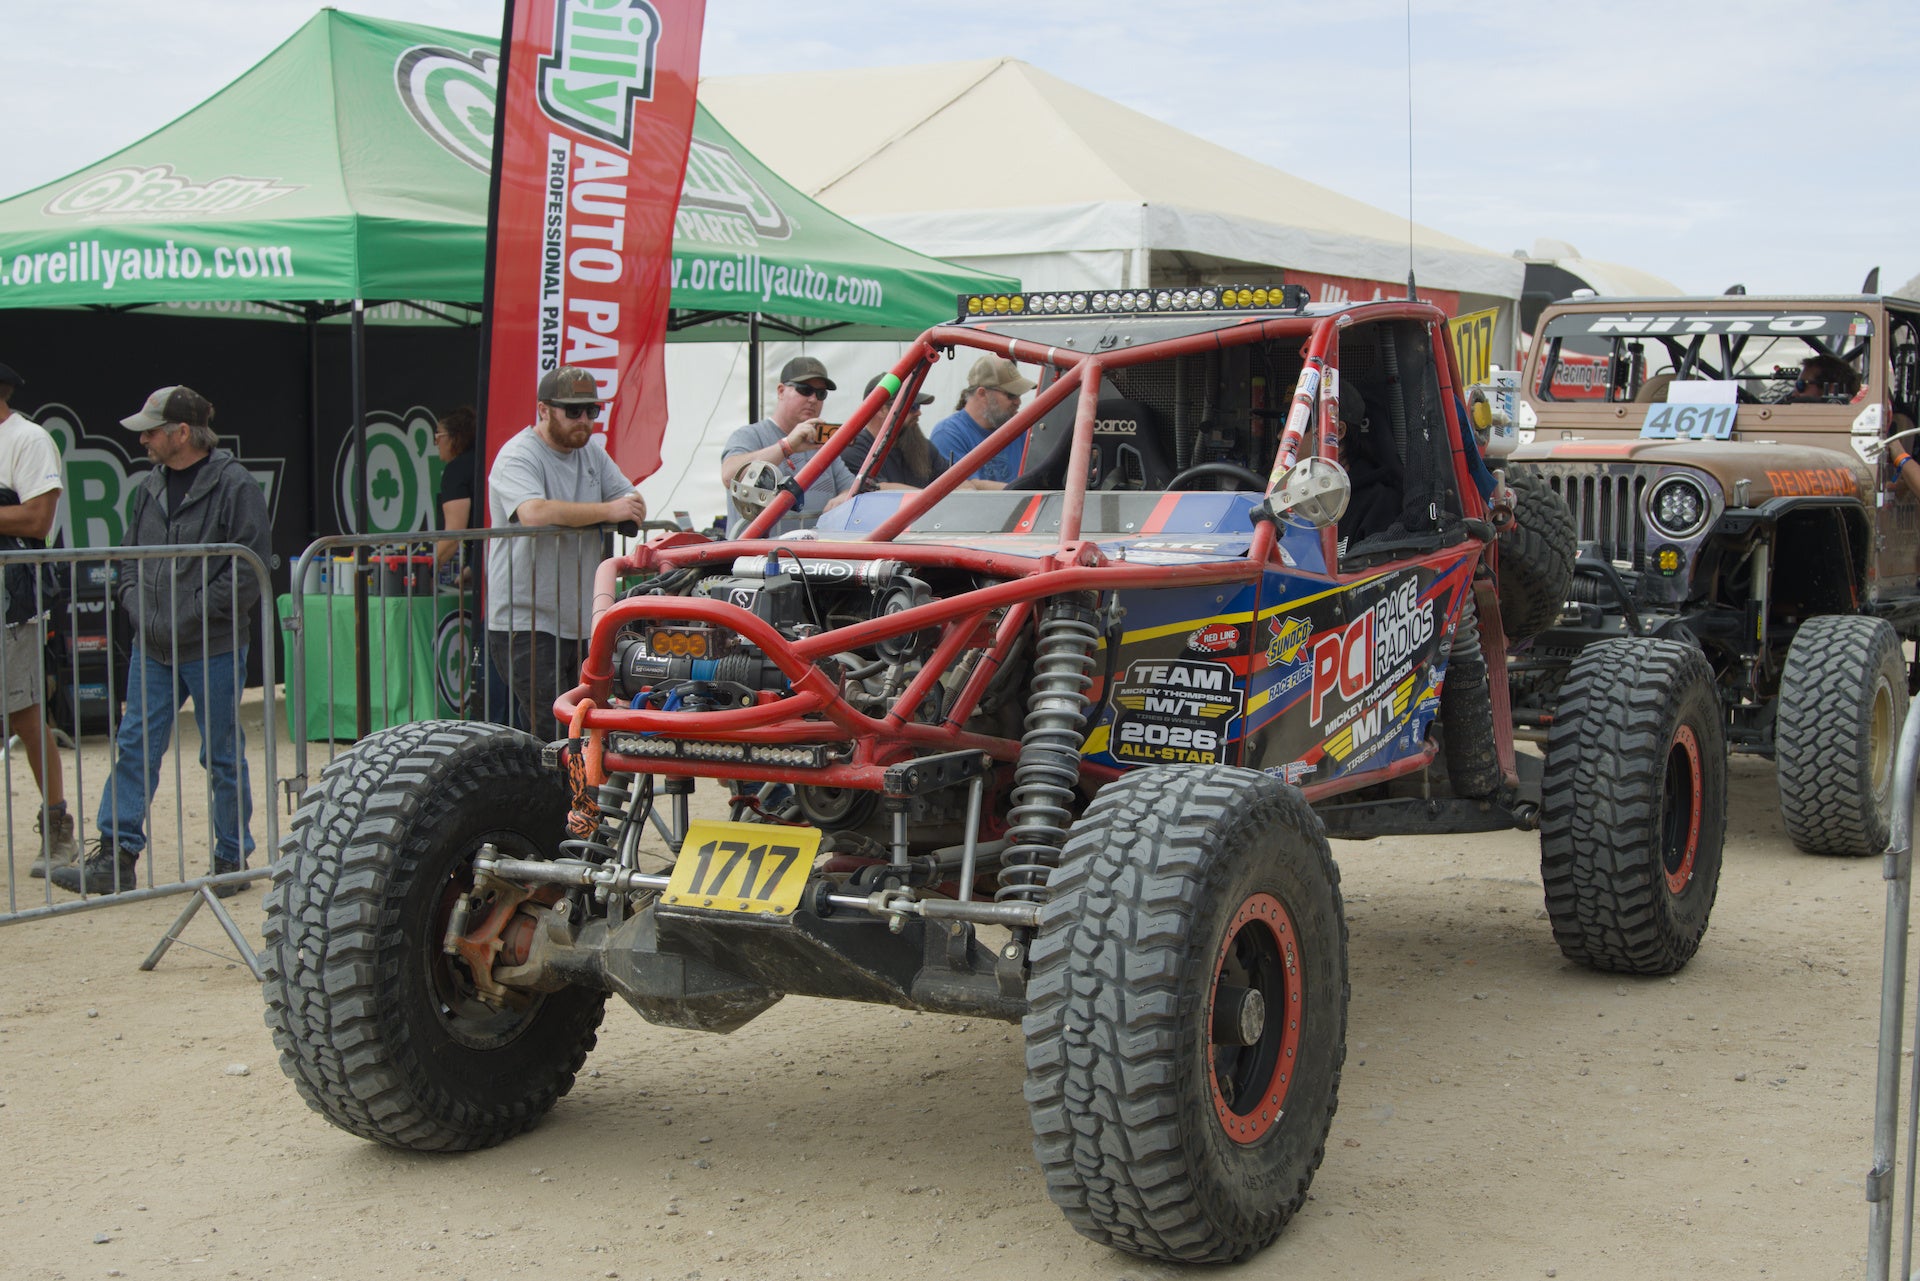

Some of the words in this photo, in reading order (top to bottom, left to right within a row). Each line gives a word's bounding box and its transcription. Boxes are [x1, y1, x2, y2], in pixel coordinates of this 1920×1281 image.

[551, 0, 645, 127] illy
[543, 149, 565, 300] PROFESSIONAL
[569, 142, 629, 284] AUTO
[681, 213, 759, 247] PARTS
[0, 240, 294, 289] .oreillyauto.com
[541, 306, 560, 373] PARTS
[1587, 315, 1827, 333] NITTO
[1456, 316, 1492, 386] 1717
[1554, 361, 1593, 391] Racing
[1593, 361, 1609, 385] Tra
[1094, 418, 1137, 433] parco
[1649, 406, 1731, 434] 4611
[781, 562, 847, 578] radflo
[1376, 575, 1418, 634] RACE
[1203, 632, 1218, 643] RED
[1220, 630, 1236, 641] LINE
[1270, 624, 1310, 661] SUNOCO
[1376, 599, 1433, 680] RADIOS
[1134, 666, 1223, 691] TEAM
[1269, 677, 1291, 701] RACE
[1292, 662, 1314, 688] FUELS
[1310, 606, 1375, 728] PCI
[1120, 688, 1161, 696] MICKEY
[1163, 689, 1232, 703] THOMPSON
[1145, 697, 1206, 716] M/T
[1325, 701, 1363, 736] MICKEY
[1366, 660, 1413, 707] THOMPSON
[1120, 721, 1217, 750] 2026
[1136, 713, 1163, 721] TIRES
[1171, 716, 1206, 726] WHEELS
[1352, 690, 1398, 749] M/T
[1119, 743, 1216, 765] ALL-STAR
[1346, 748, 1370, 772] TIRES
[1376, 722, 1403, 748] WHEELS
[687, 840, 801, 901] 1717
